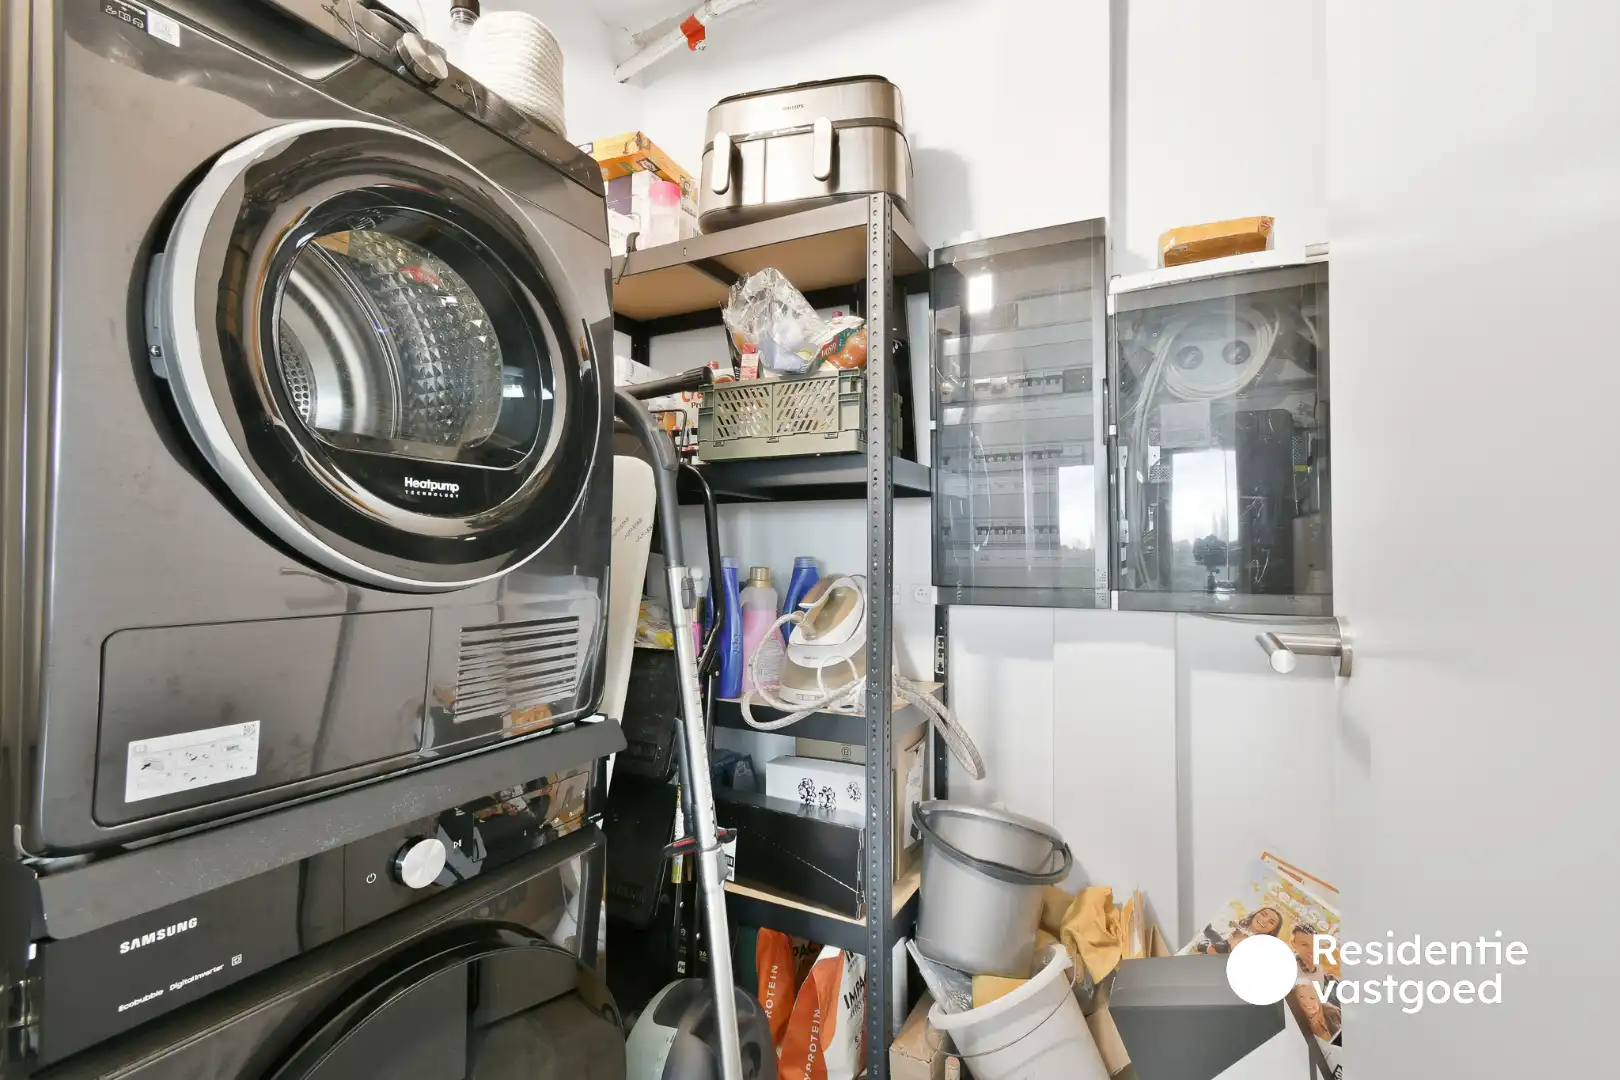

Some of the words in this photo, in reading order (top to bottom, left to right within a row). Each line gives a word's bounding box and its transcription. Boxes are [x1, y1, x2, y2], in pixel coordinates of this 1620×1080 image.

[404, 476, 460, 494] Heatpump
[404, 489, 460, 499] TECHNOLOGY
[119, 917, 198, 954] SAMSUNG
